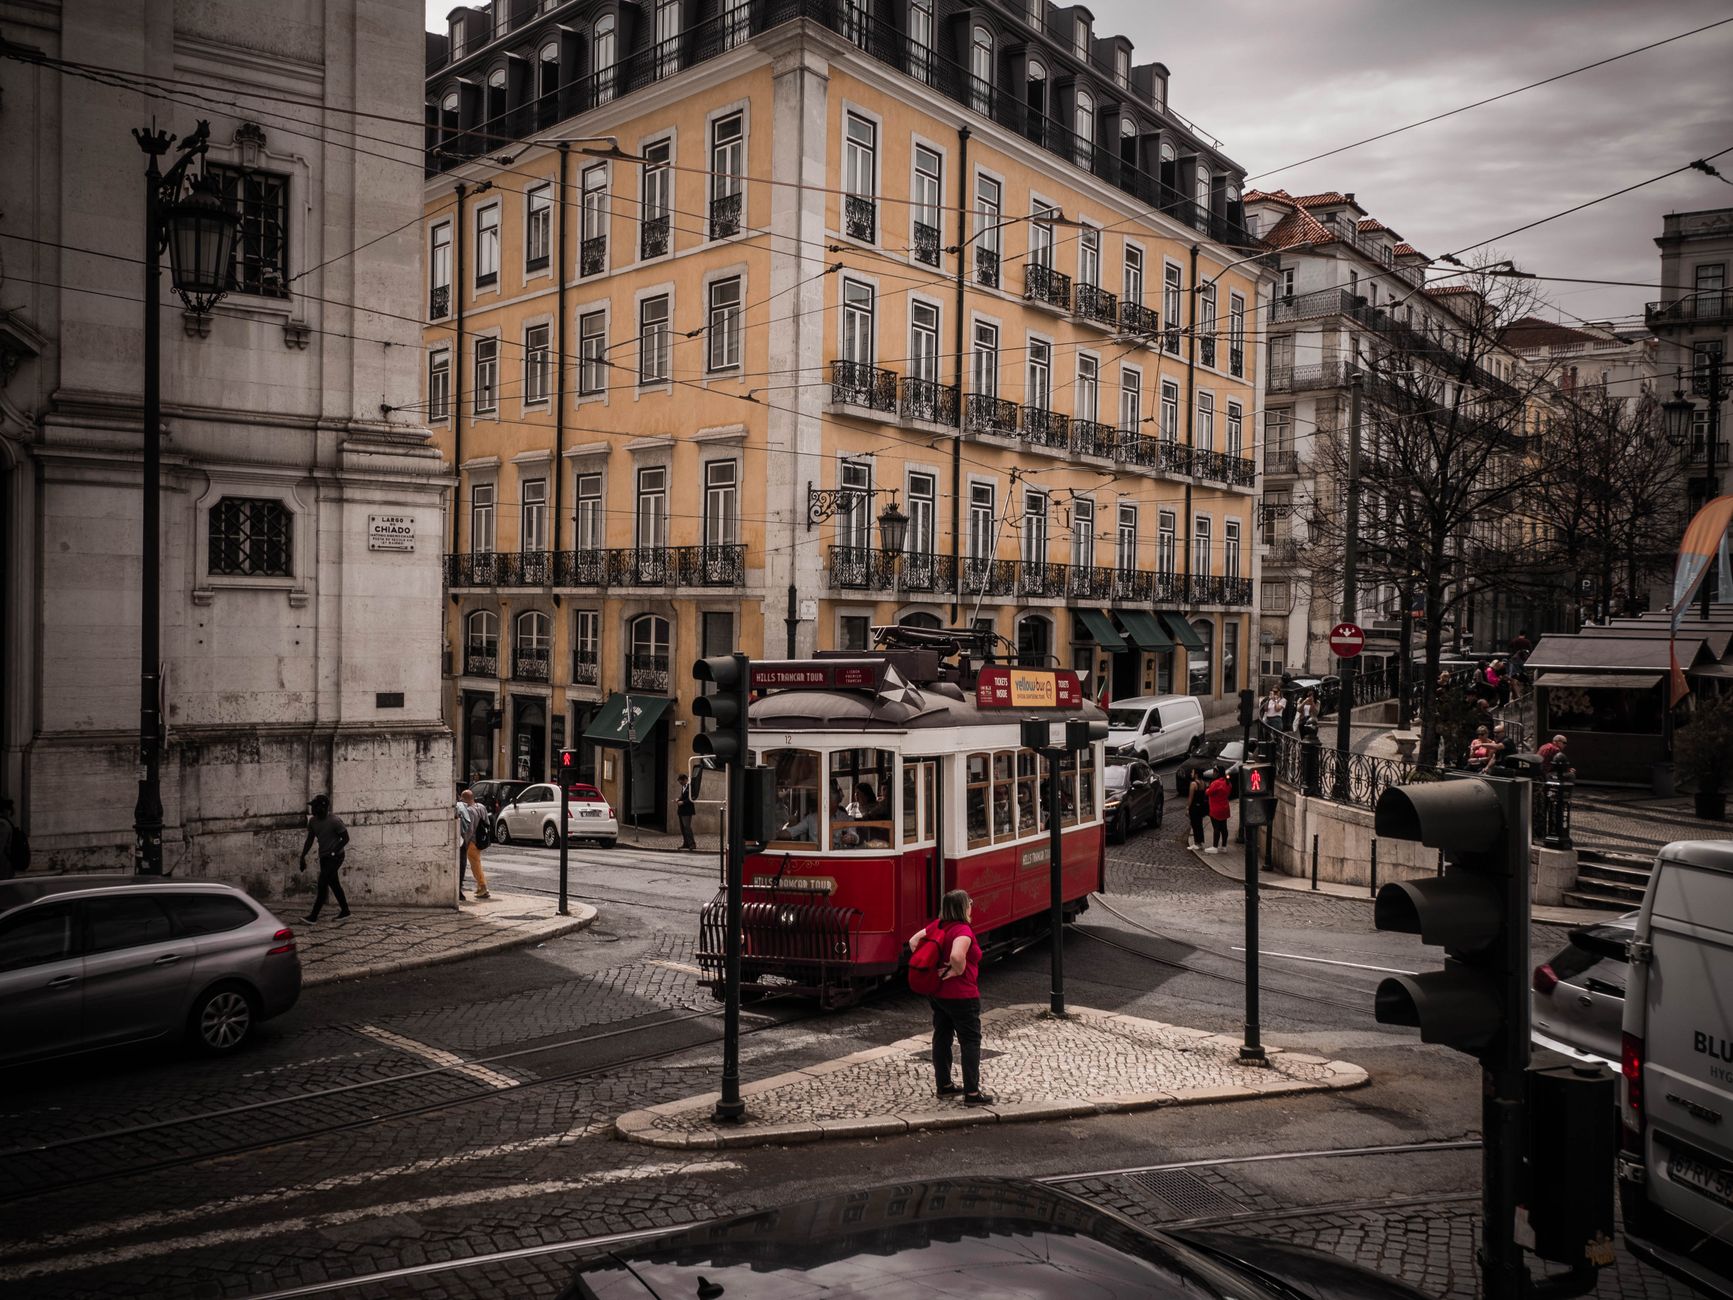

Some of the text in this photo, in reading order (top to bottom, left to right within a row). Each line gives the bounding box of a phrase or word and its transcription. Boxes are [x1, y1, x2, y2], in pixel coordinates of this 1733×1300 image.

[374, 526, 411, 534] CHIADO
[756, 673, 824, 682] HILLS TRAMCAR TOUR
[994, 677, 1008, 687] TICKETS
[996, 689, 1008, 699] INSIDE
[785, 735, 792, 745] 12
[754, 877, 832, 890] HILLS RAMCAR TOUR
[1694, 1030, 1733, 1063] BLU
[1710, 1065, 1733, 1084] HYG
